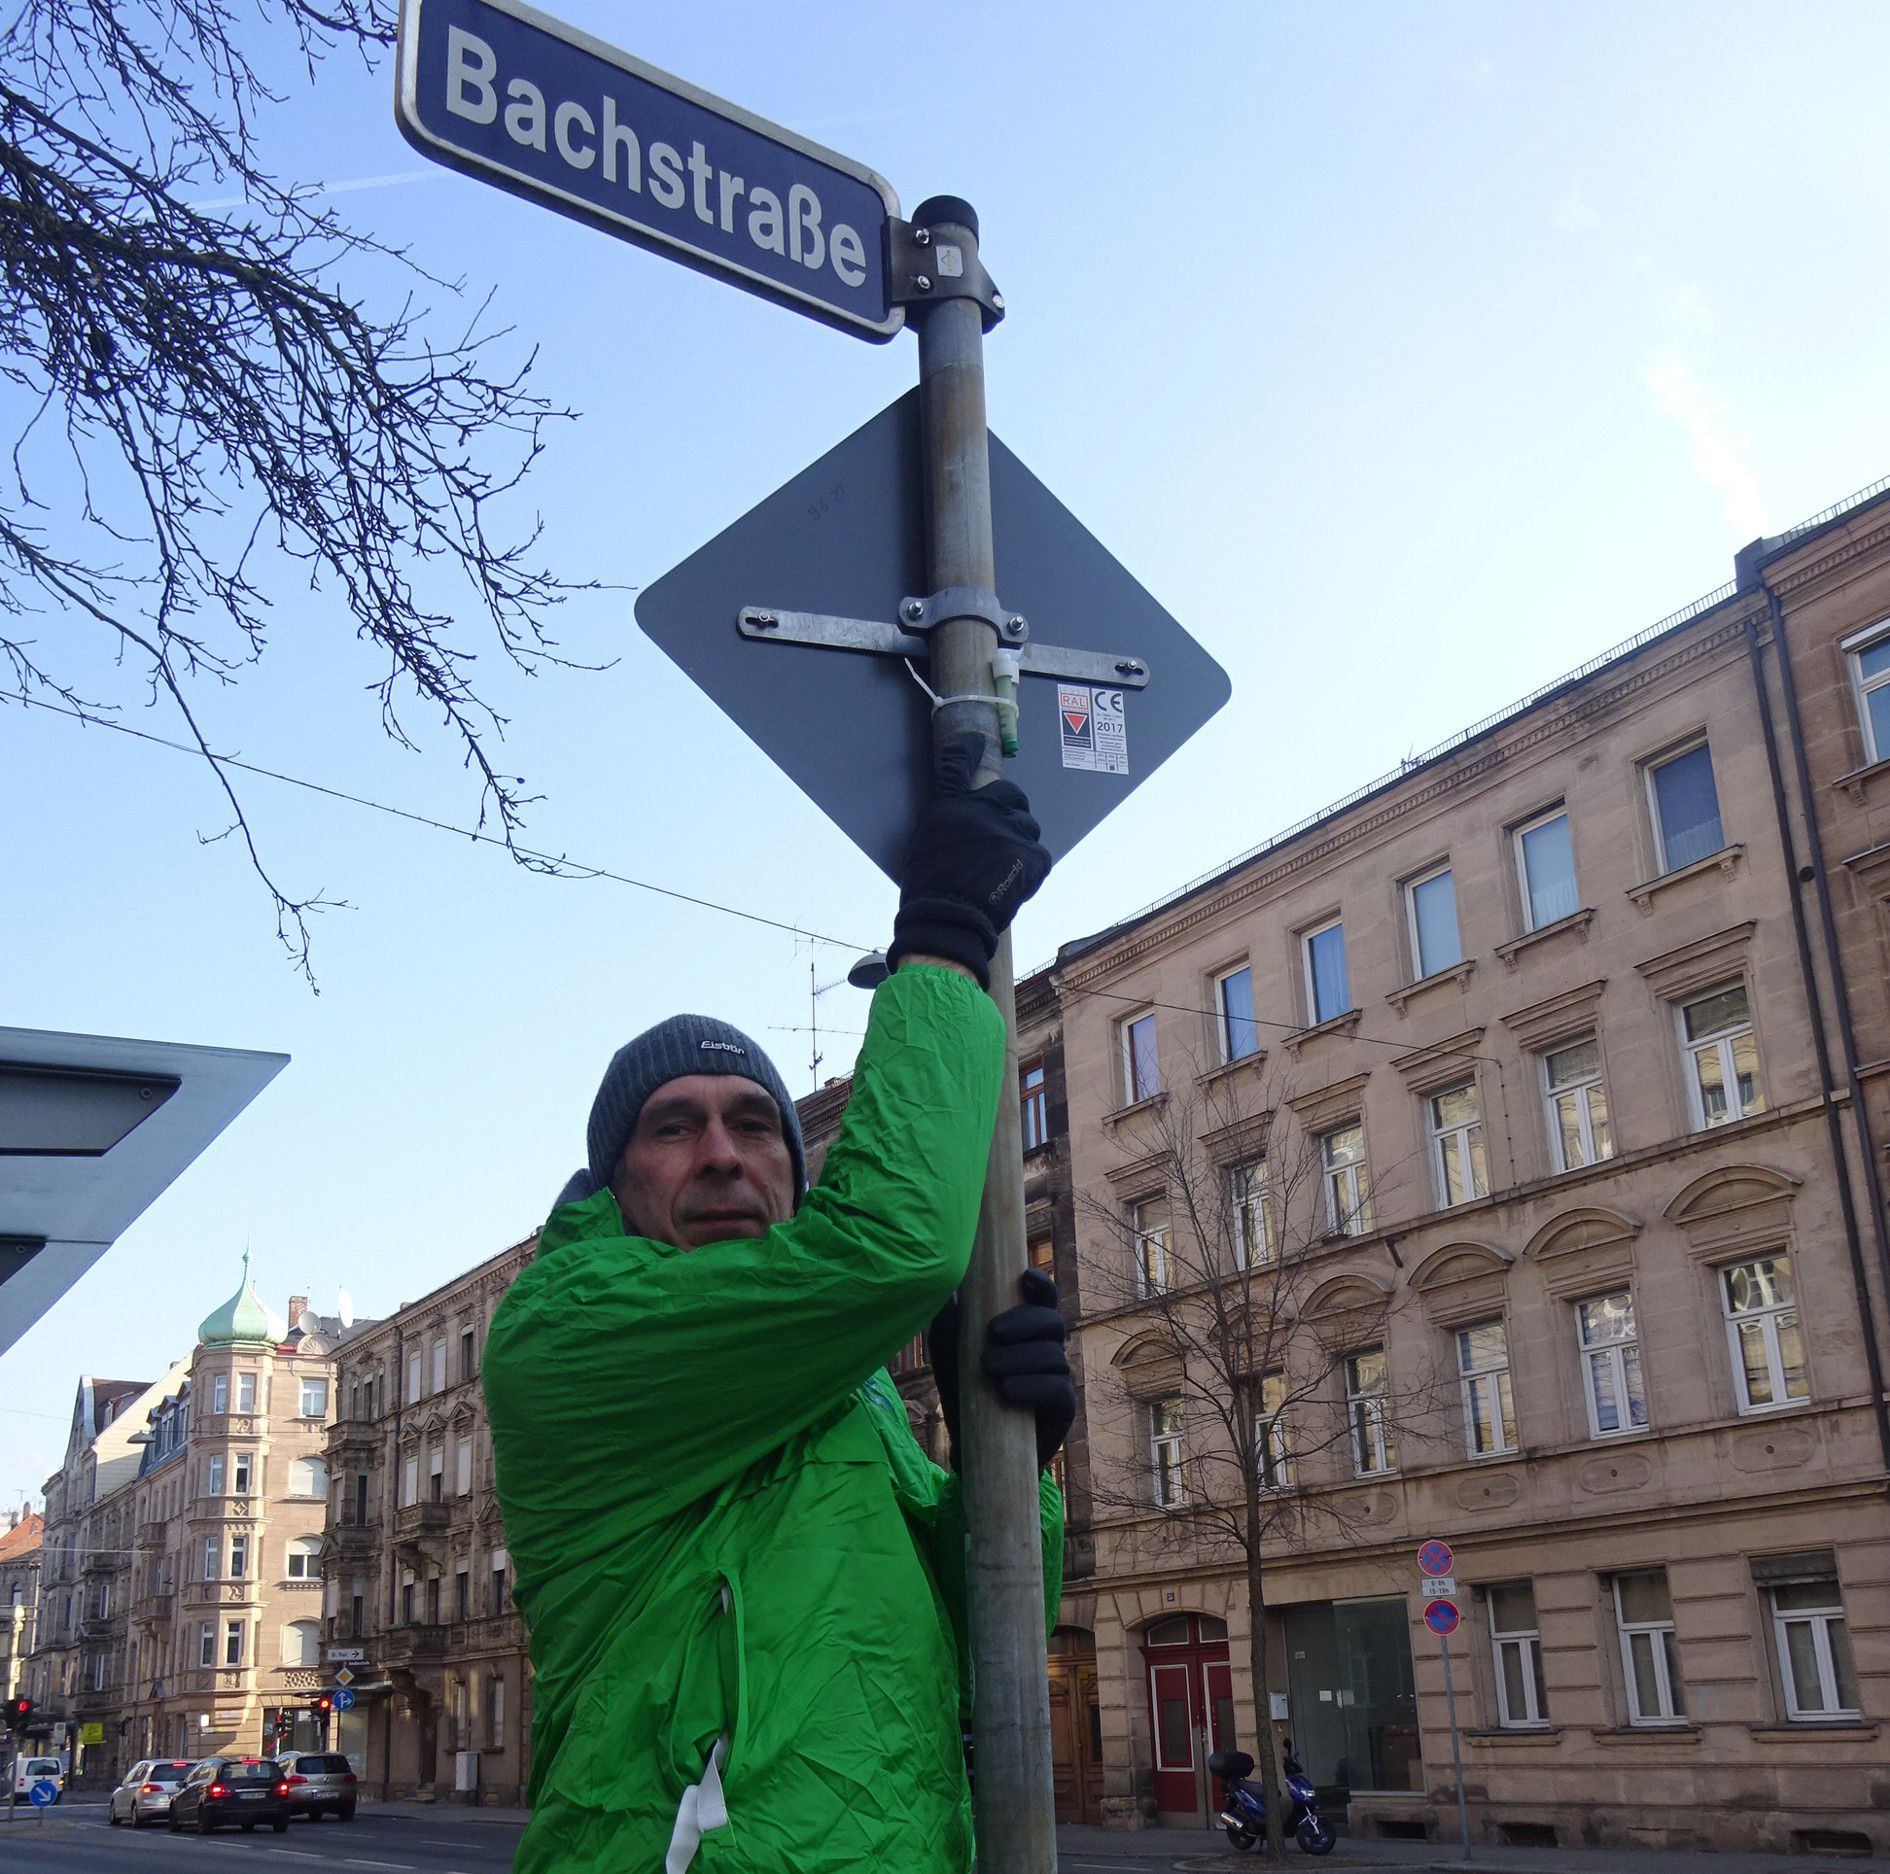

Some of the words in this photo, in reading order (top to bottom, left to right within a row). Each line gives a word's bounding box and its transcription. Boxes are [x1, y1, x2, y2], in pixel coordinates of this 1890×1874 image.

[446, 25, 867, 288] Bachstraße
[1062, 694, 1086, 707] RAL
[1097, 722, 1123, 733] 2017
